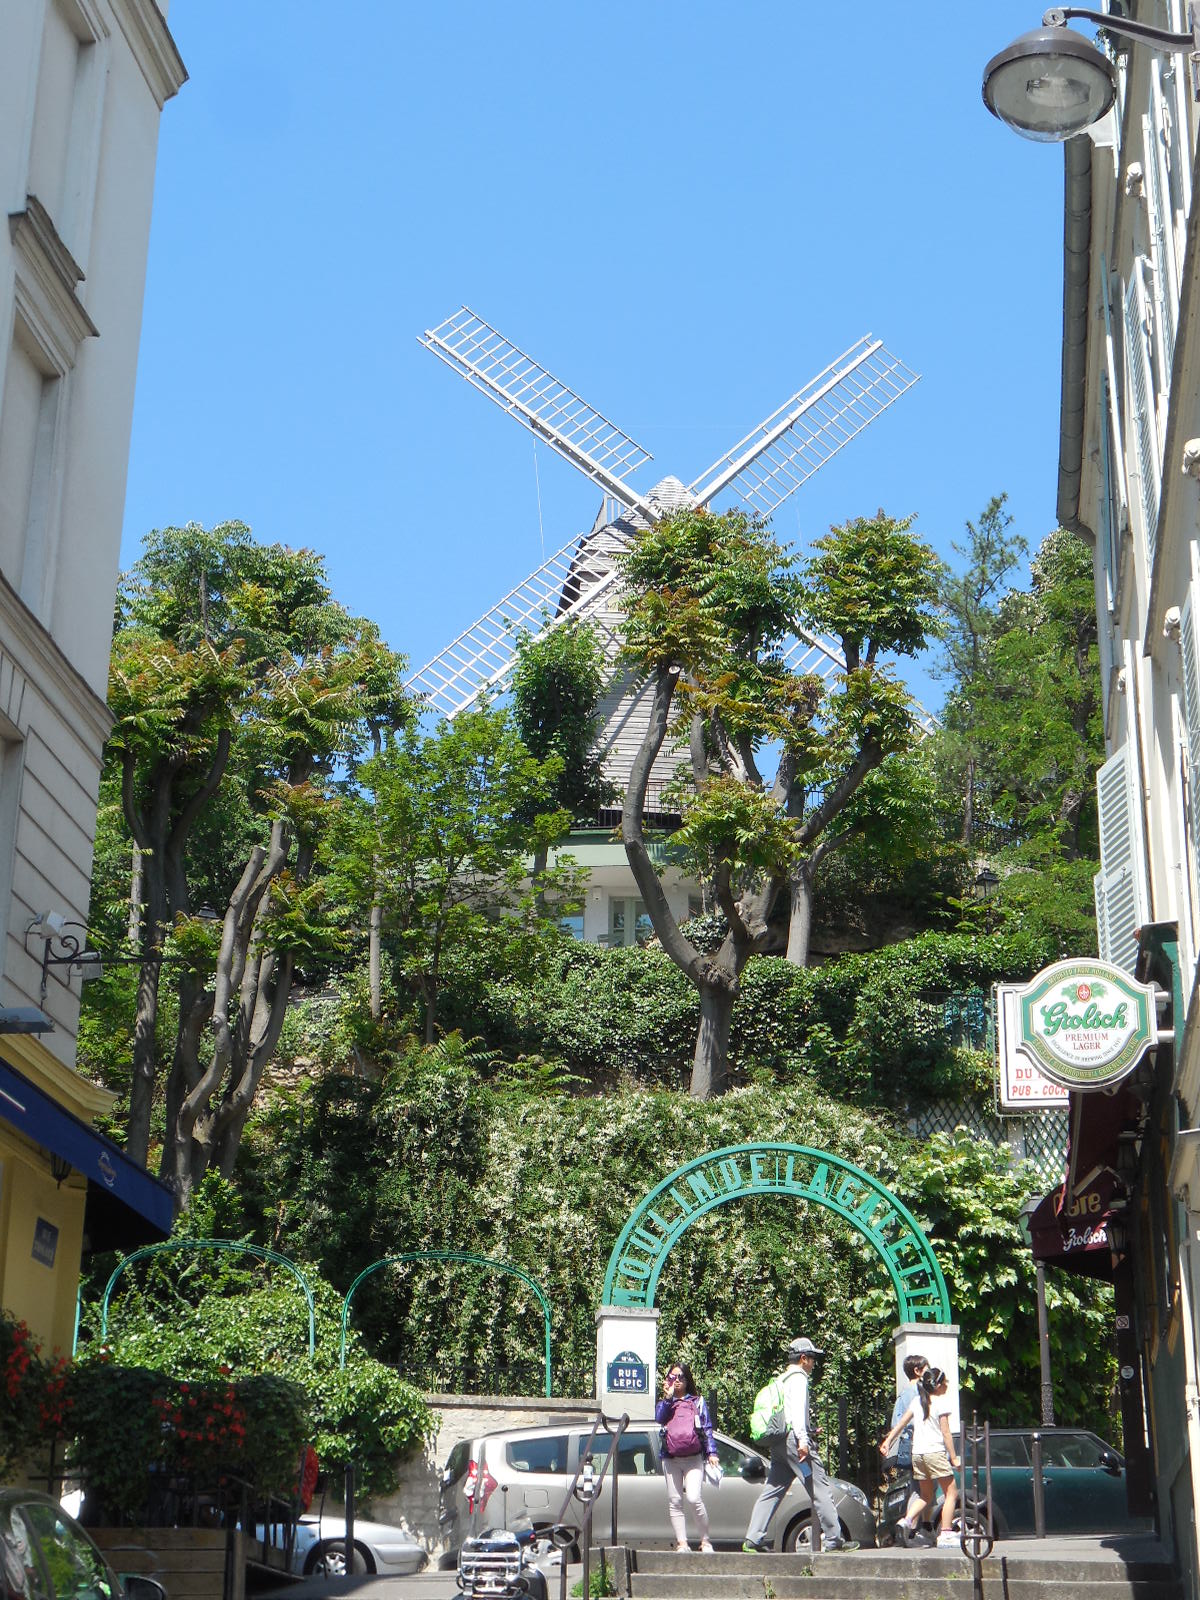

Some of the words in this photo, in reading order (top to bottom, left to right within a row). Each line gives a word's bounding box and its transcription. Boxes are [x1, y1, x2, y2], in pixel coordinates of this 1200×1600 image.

[1040, 1002, 1128, 1036] Grolsch
[1065, 1032, 1109, 1042] PREMIUM
[1073, 1042, 1102, 1051] LAGER
[1015, 1068, 1032, 1079] DU
[1012, 1085, 1031, 1097] PUB
[612, 1170, 716, 1308] MOULIN
[718, 1153, 771, 1193] DE
[785, 1155, 830, 1197] LA
[835, 1176, 944, 1323] GALETTE
[1061, 1221, 1107, 1251] Grolsch
[618, 1368, 638, 1378] RUE
[613, 1378, 643, 1388] LEPIC
